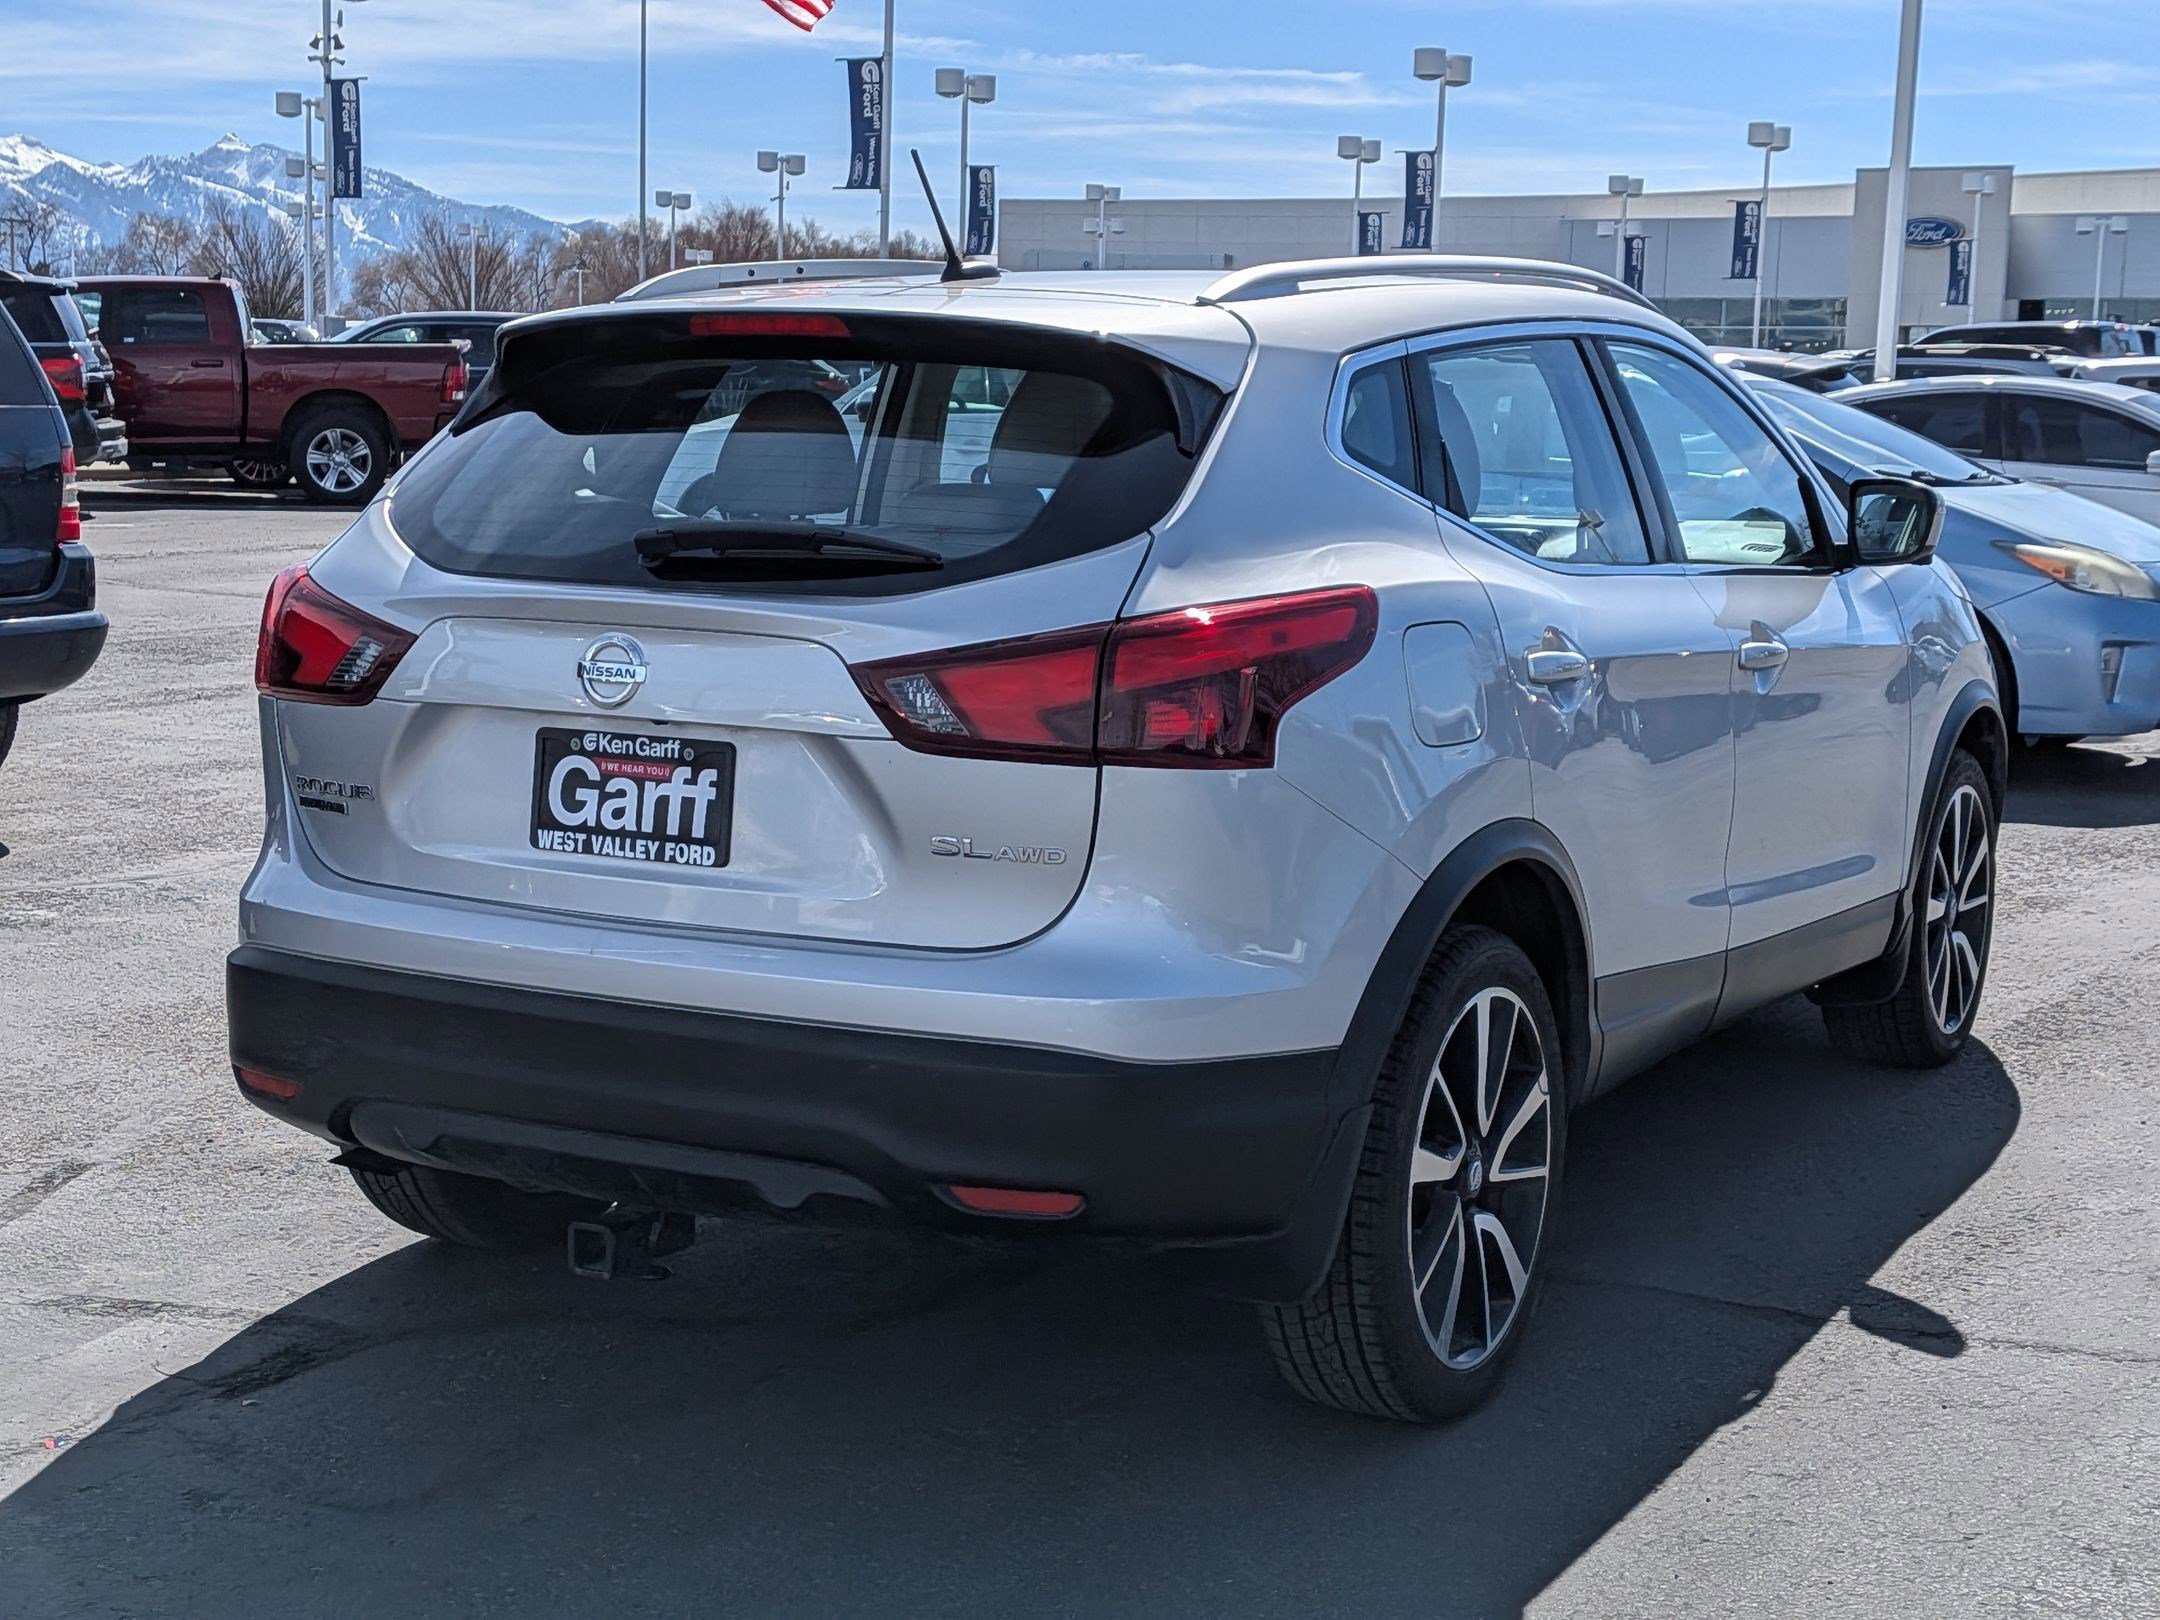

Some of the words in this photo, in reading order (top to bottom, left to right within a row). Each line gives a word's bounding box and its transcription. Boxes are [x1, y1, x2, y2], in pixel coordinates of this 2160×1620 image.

[862, 84, 873, 118] Ford
[873, 84, 881, 104] Ken
[342, 102, 351, 132] Ford
[873, 105, 881, 129] Garff
[868, 137, 876, 160] West
[866, 160, 876, 186] Valley
[1416, 170, 1425, 195] Ford
[979, 184, 987, 208] Ford
[1906, 222, 1948, 241] Ford
[583, 664, 637, 679] NISSAN
[599, 734, 634, 755] Ken
[636, 737, 680, 760] Garff
[607, 762, 619, 772] WE
[622, 764, 645, 774] HEAR
[646, 766, 664, 776] YOU
[296, 774, 374, 800] ROGUE
[548, 755, 718, 838] Garff
[537, 829, 587, 853] WEST
[591, 834, 661, 860] VALLEY
[664, 842, 716, 866] FORD
[930, 835, 993, 859] SL
[994, 846, 1067, 865] AWD
